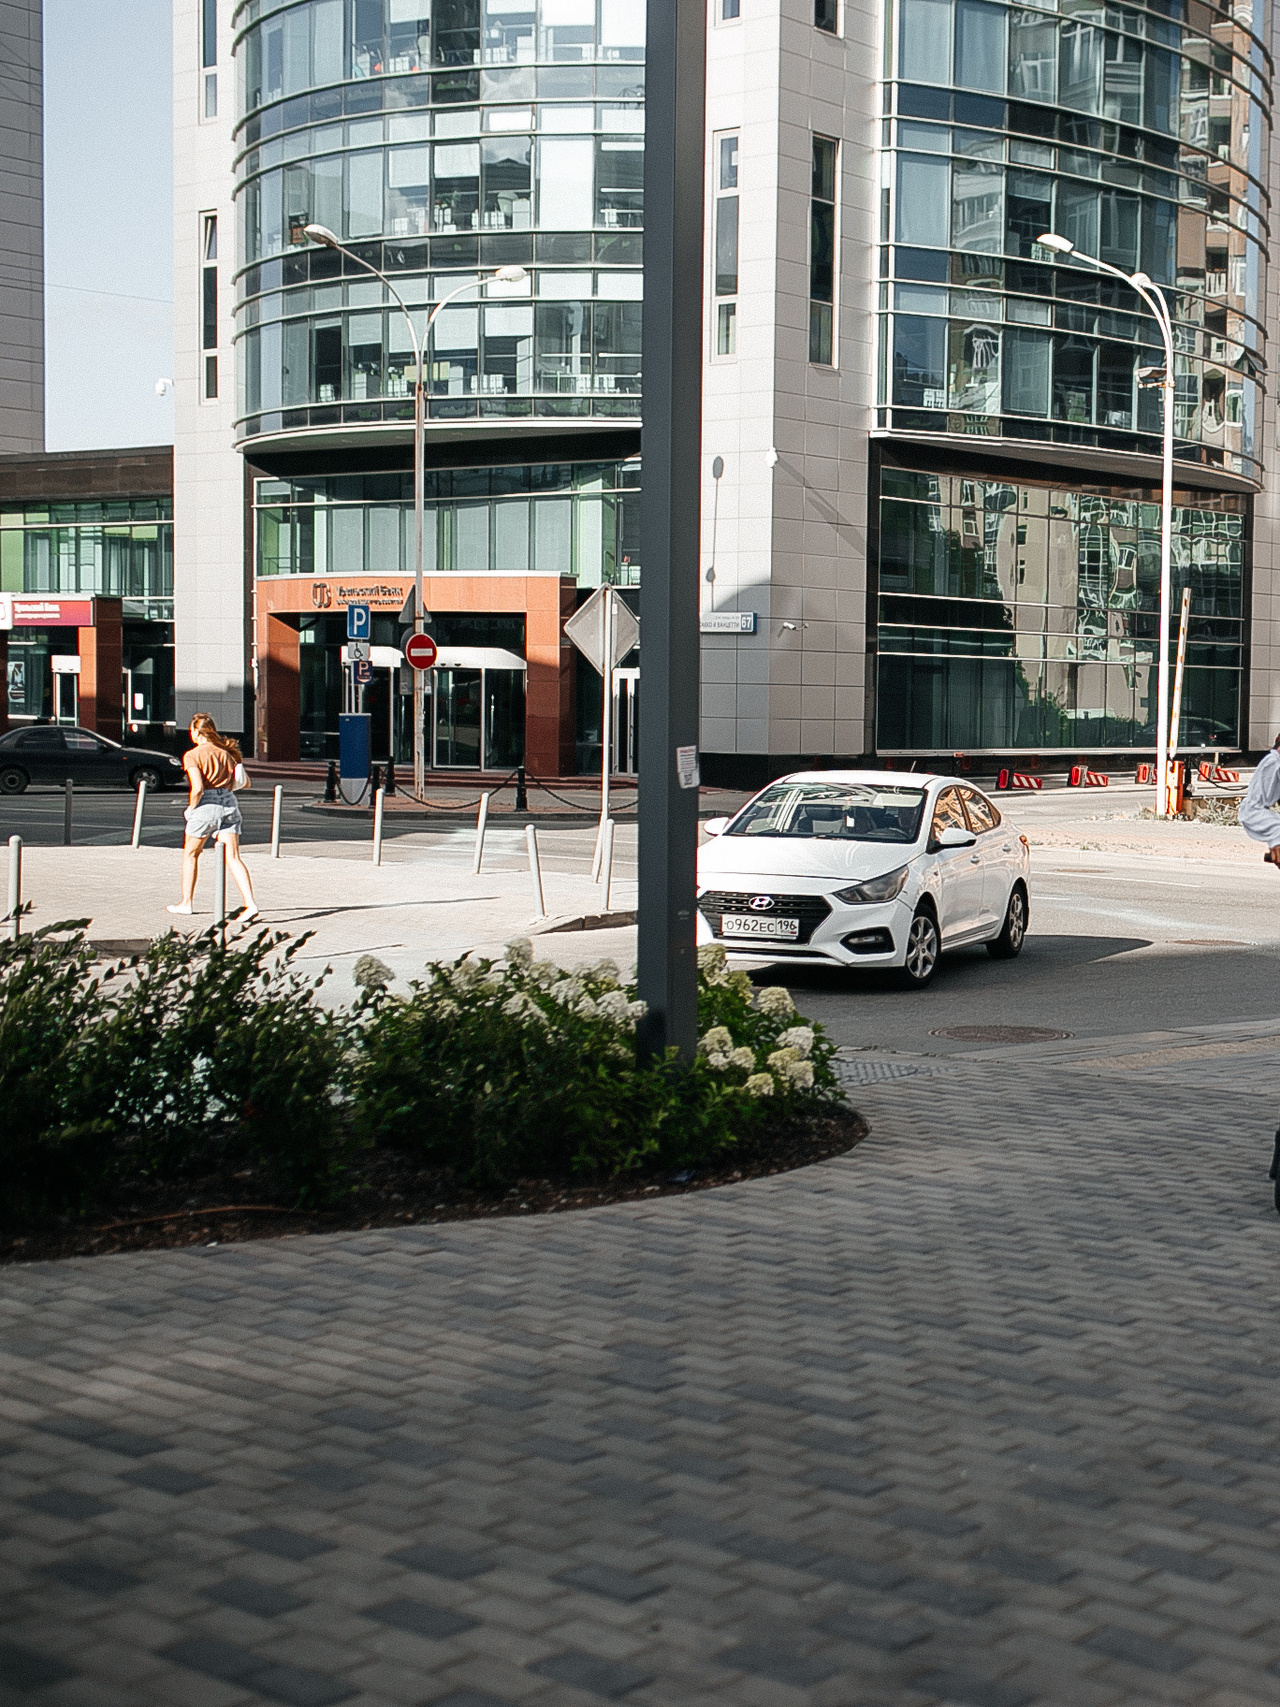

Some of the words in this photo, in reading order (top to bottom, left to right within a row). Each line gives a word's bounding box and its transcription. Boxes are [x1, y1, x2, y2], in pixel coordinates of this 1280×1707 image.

[353, 608, 366, 635] P
[742, 616, 751, 629] 67
[777, 920, 797, 931] 196
